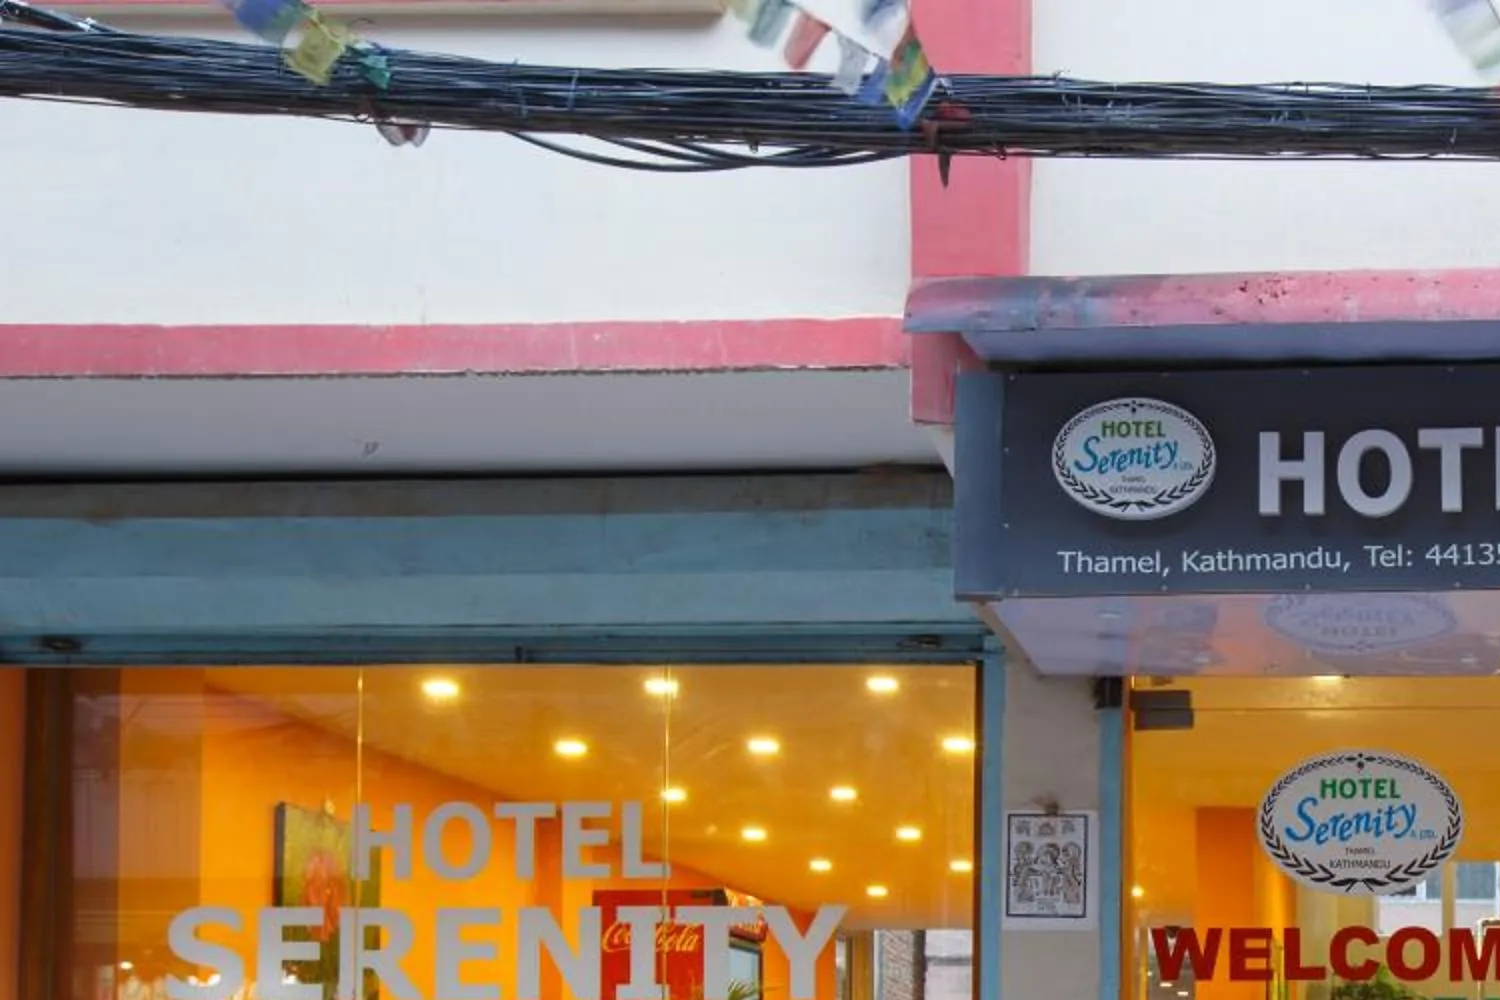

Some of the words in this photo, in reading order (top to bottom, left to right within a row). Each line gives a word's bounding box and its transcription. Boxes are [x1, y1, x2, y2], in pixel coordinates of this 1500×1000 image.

[1102, 421, 1166, 438] HOTEL
[1073, 435, 1179, 474] Serenity
[1057, 550, 1170, 577] Thamel,
[1182, 546, 1351, 574] Kathmandu,
[1363, 544, 1413, 567] Tel:
[1320, 779, 1401, 799] HOTEL
[1285, 796, 1417, 845] Serenity
[350, 802, 671, 880] HOTEL
